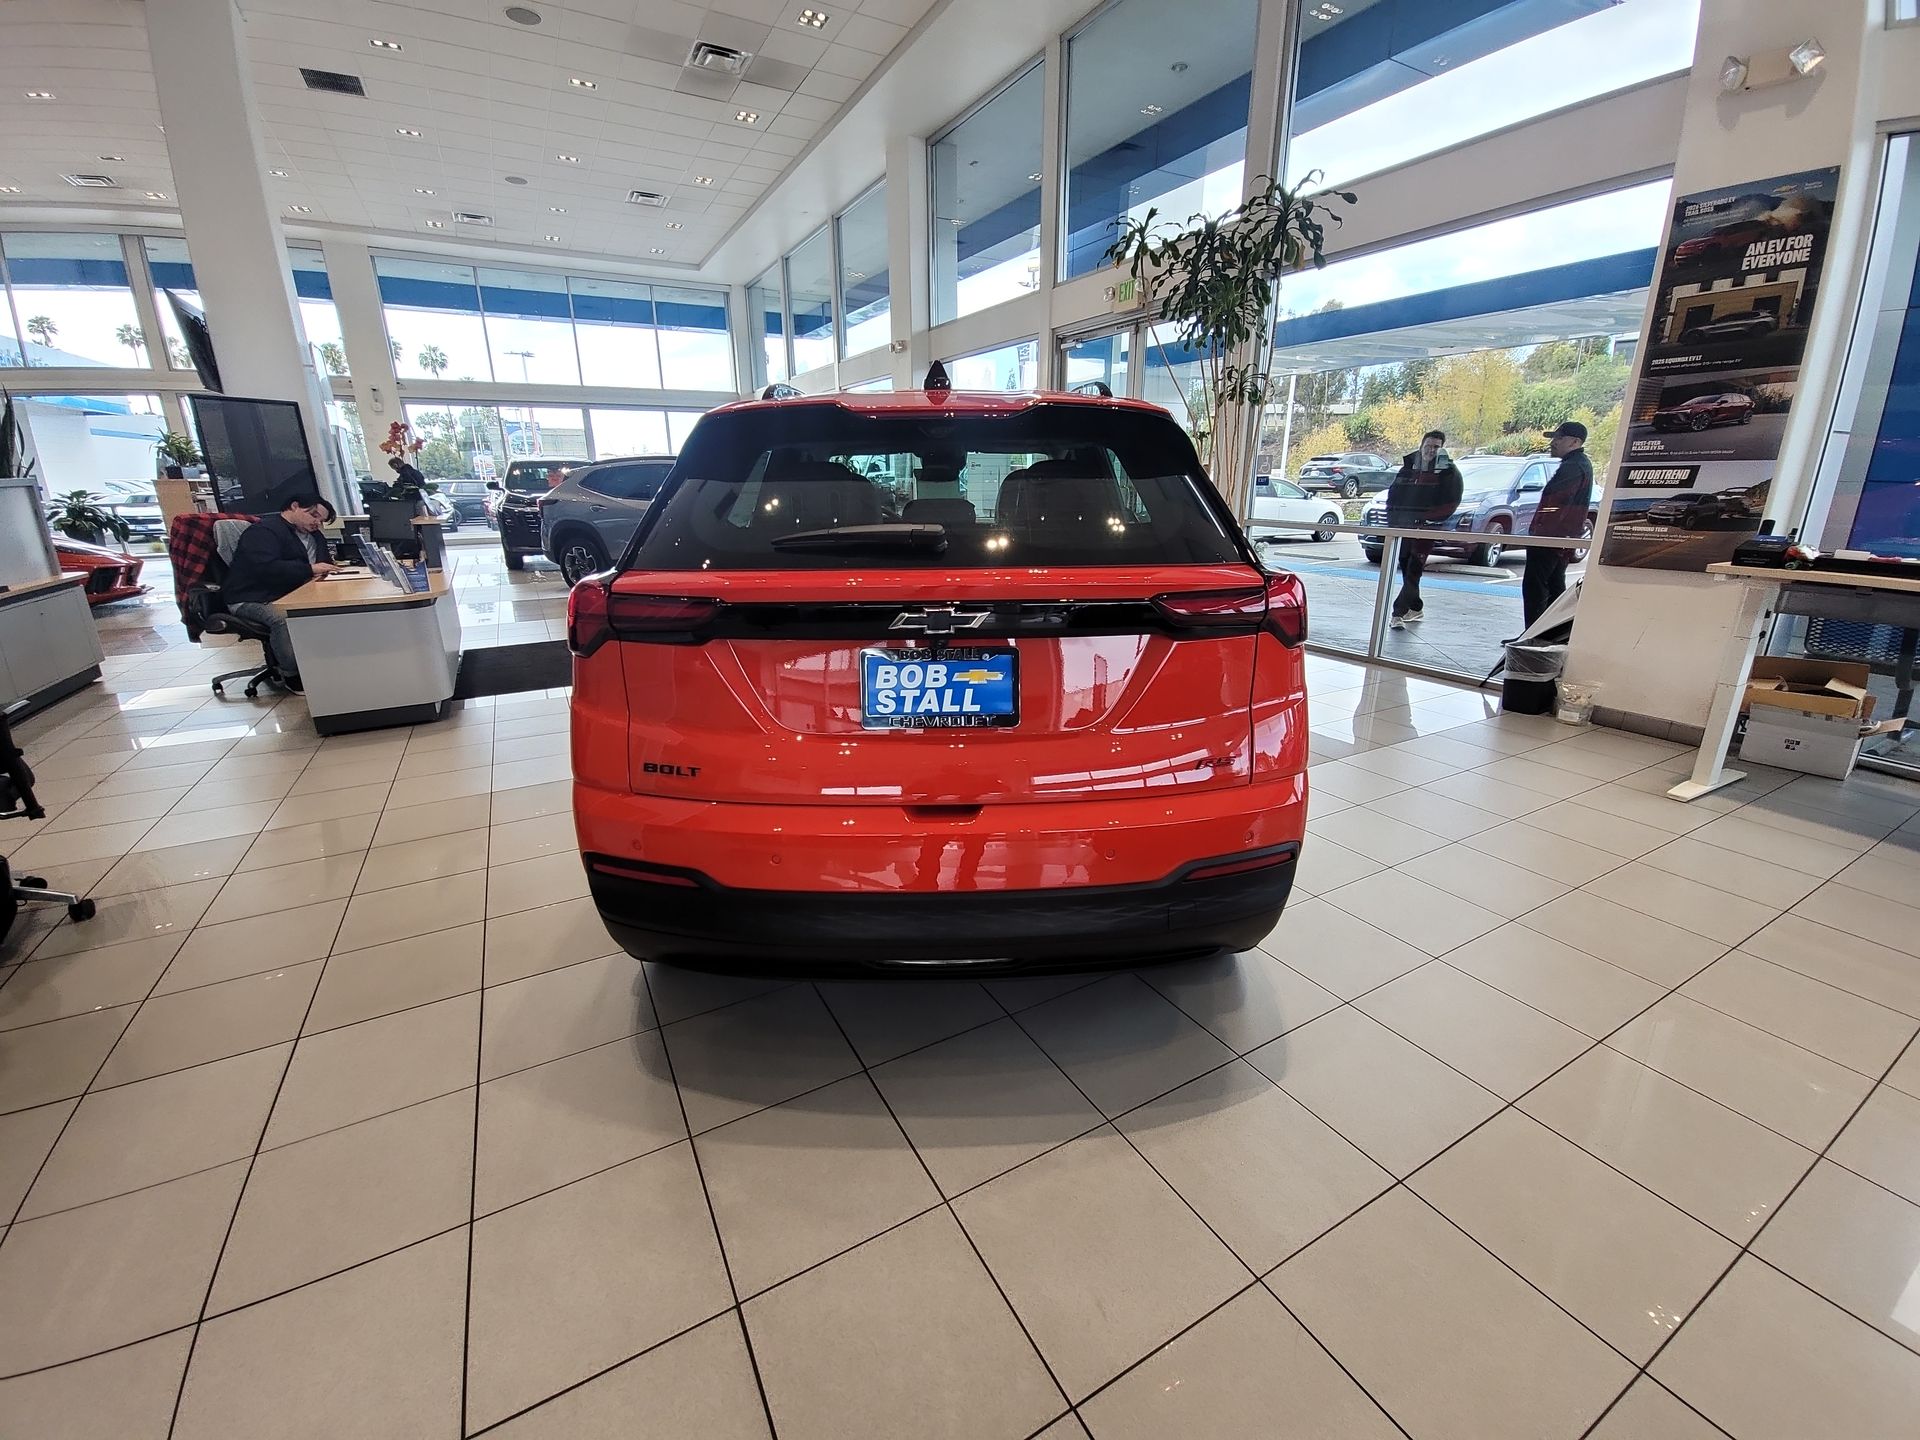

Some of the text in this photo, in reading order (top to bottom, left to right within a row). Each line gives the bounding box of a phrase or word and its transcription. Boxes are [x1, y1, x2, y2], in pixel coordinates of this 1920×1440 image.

[1745, 234, 1814, 257] AN EV FOR
[1741, 248, 1812, 271] EVERYONE
[1119, 280, 1136, 302] EXIT
[1628, 469, 1691, 480] MOTORTREND
[899, 648, 981, 661] BOB STALL
[875, 664, 948, 689] BOB
[875, 688, 981, 714] STALL
[888, 715, 997, 728] CHEVROLET
[643, 762, 702, 777] BOLT
